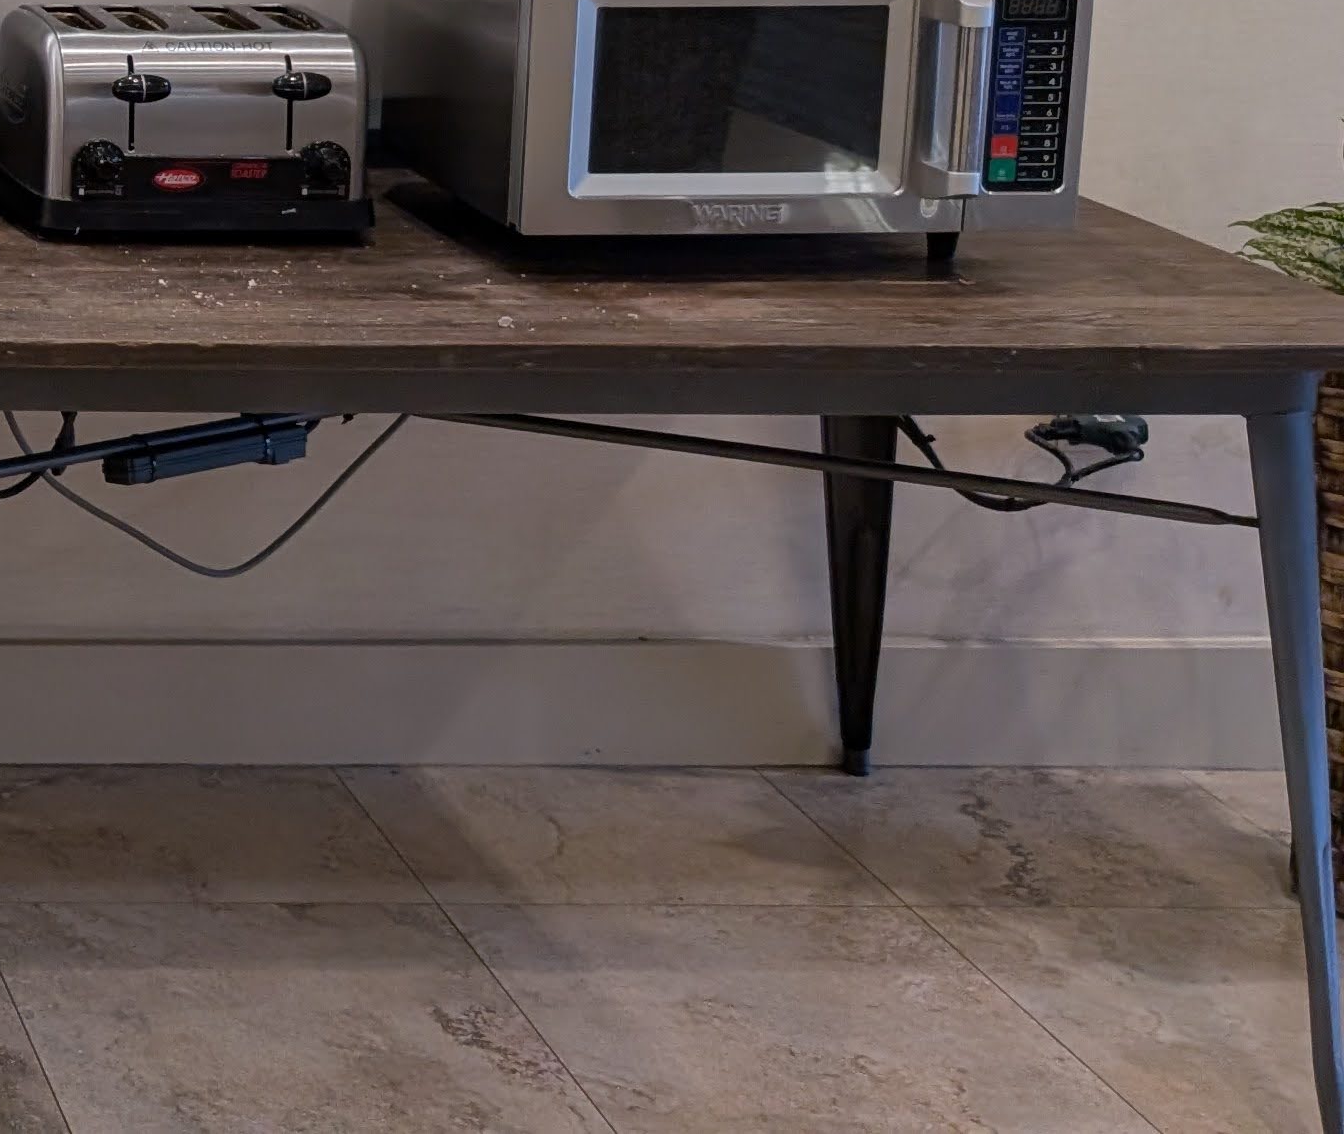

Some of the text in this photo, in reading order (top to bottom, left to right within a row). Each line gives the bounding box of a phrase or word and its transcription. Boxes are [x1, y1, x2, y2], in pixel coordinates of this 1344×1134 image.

[1053, 31, 1058, 39] 1
[1051, 47, 1058, 55] 2
[1050, 62, 1057, 70] 3
[1047, 93, 1054, 102] 5
[1046, 109, 1052, 117] 6
[1044, 139, 1051, 147] 8
[1043, 154, 1049, 162] 9
[1041, 170, 1048, 178] 0
